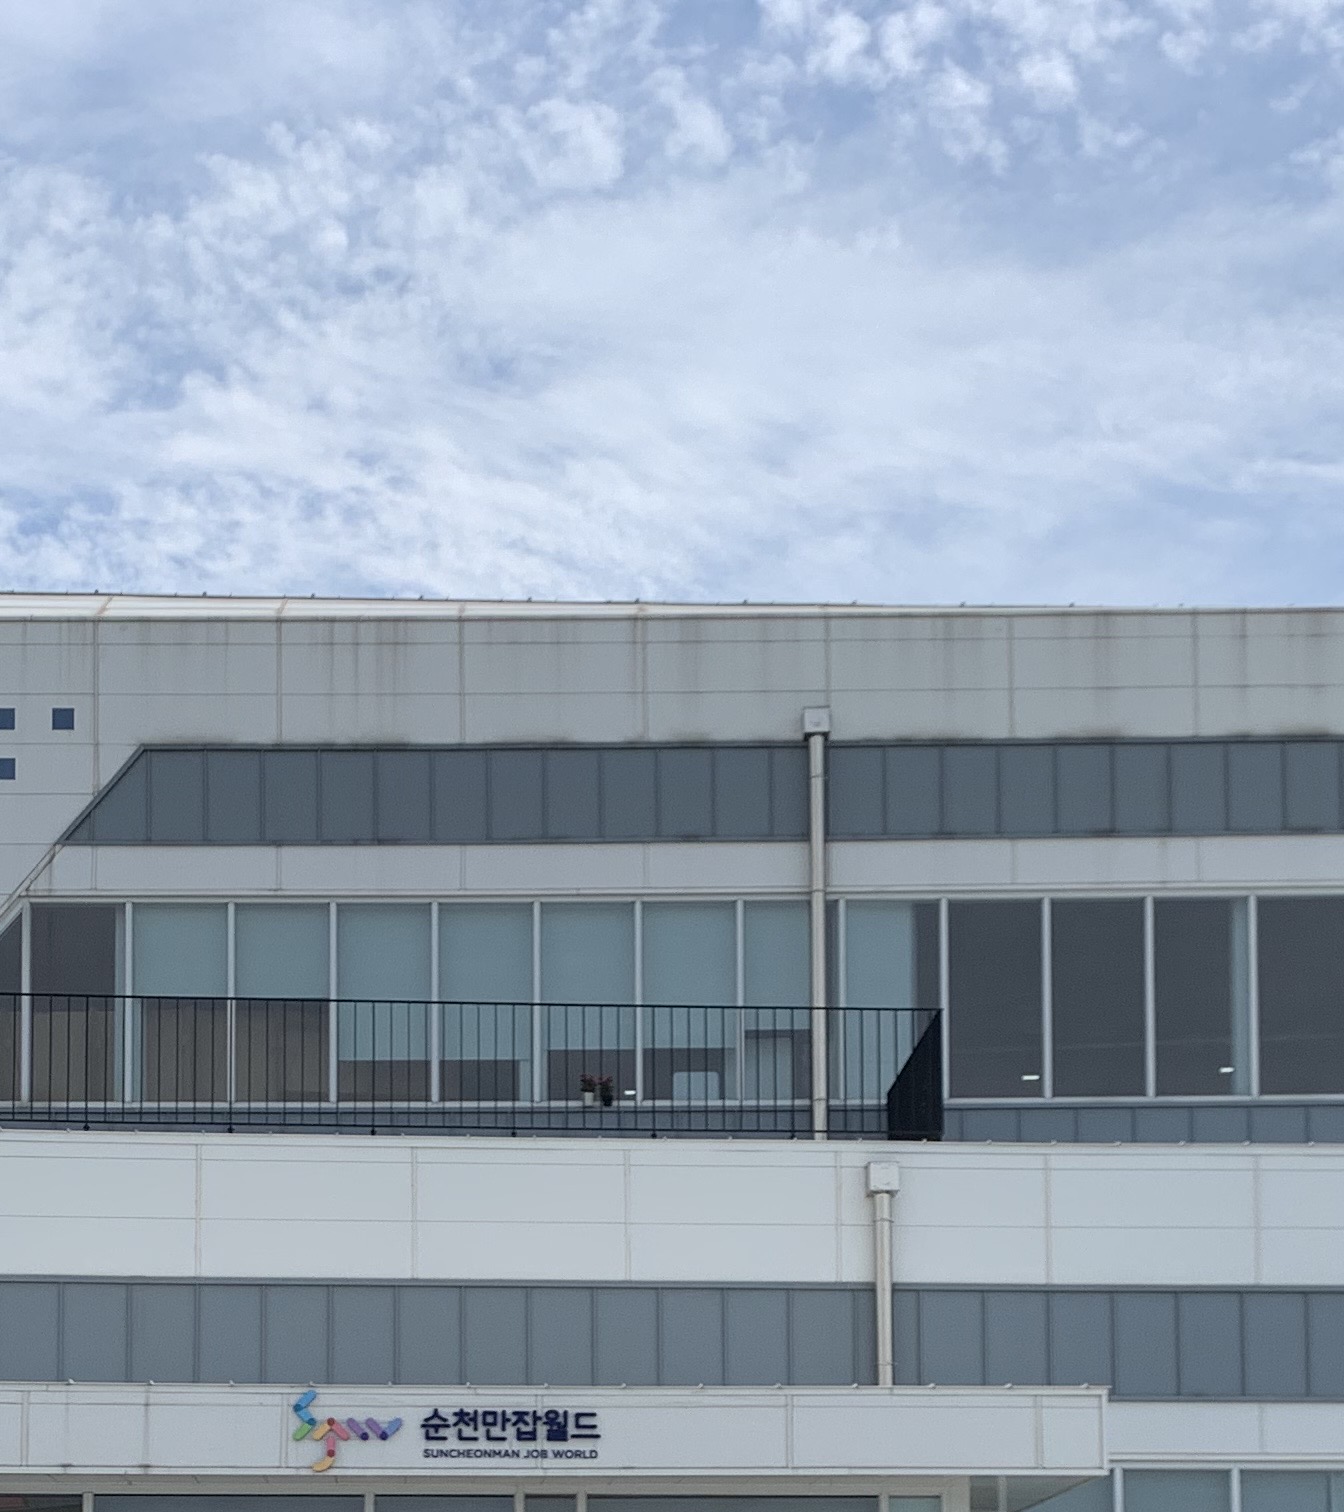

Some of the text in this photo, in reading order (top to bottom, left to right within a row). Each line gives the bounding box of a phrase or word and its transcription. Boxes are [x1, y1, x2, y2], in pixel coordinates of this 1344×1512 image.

[420, 1408, 602, 1443] 순천만잡월드
[423, 1449, 599, 1460] SUNCHEONMAN JOB WORLD
